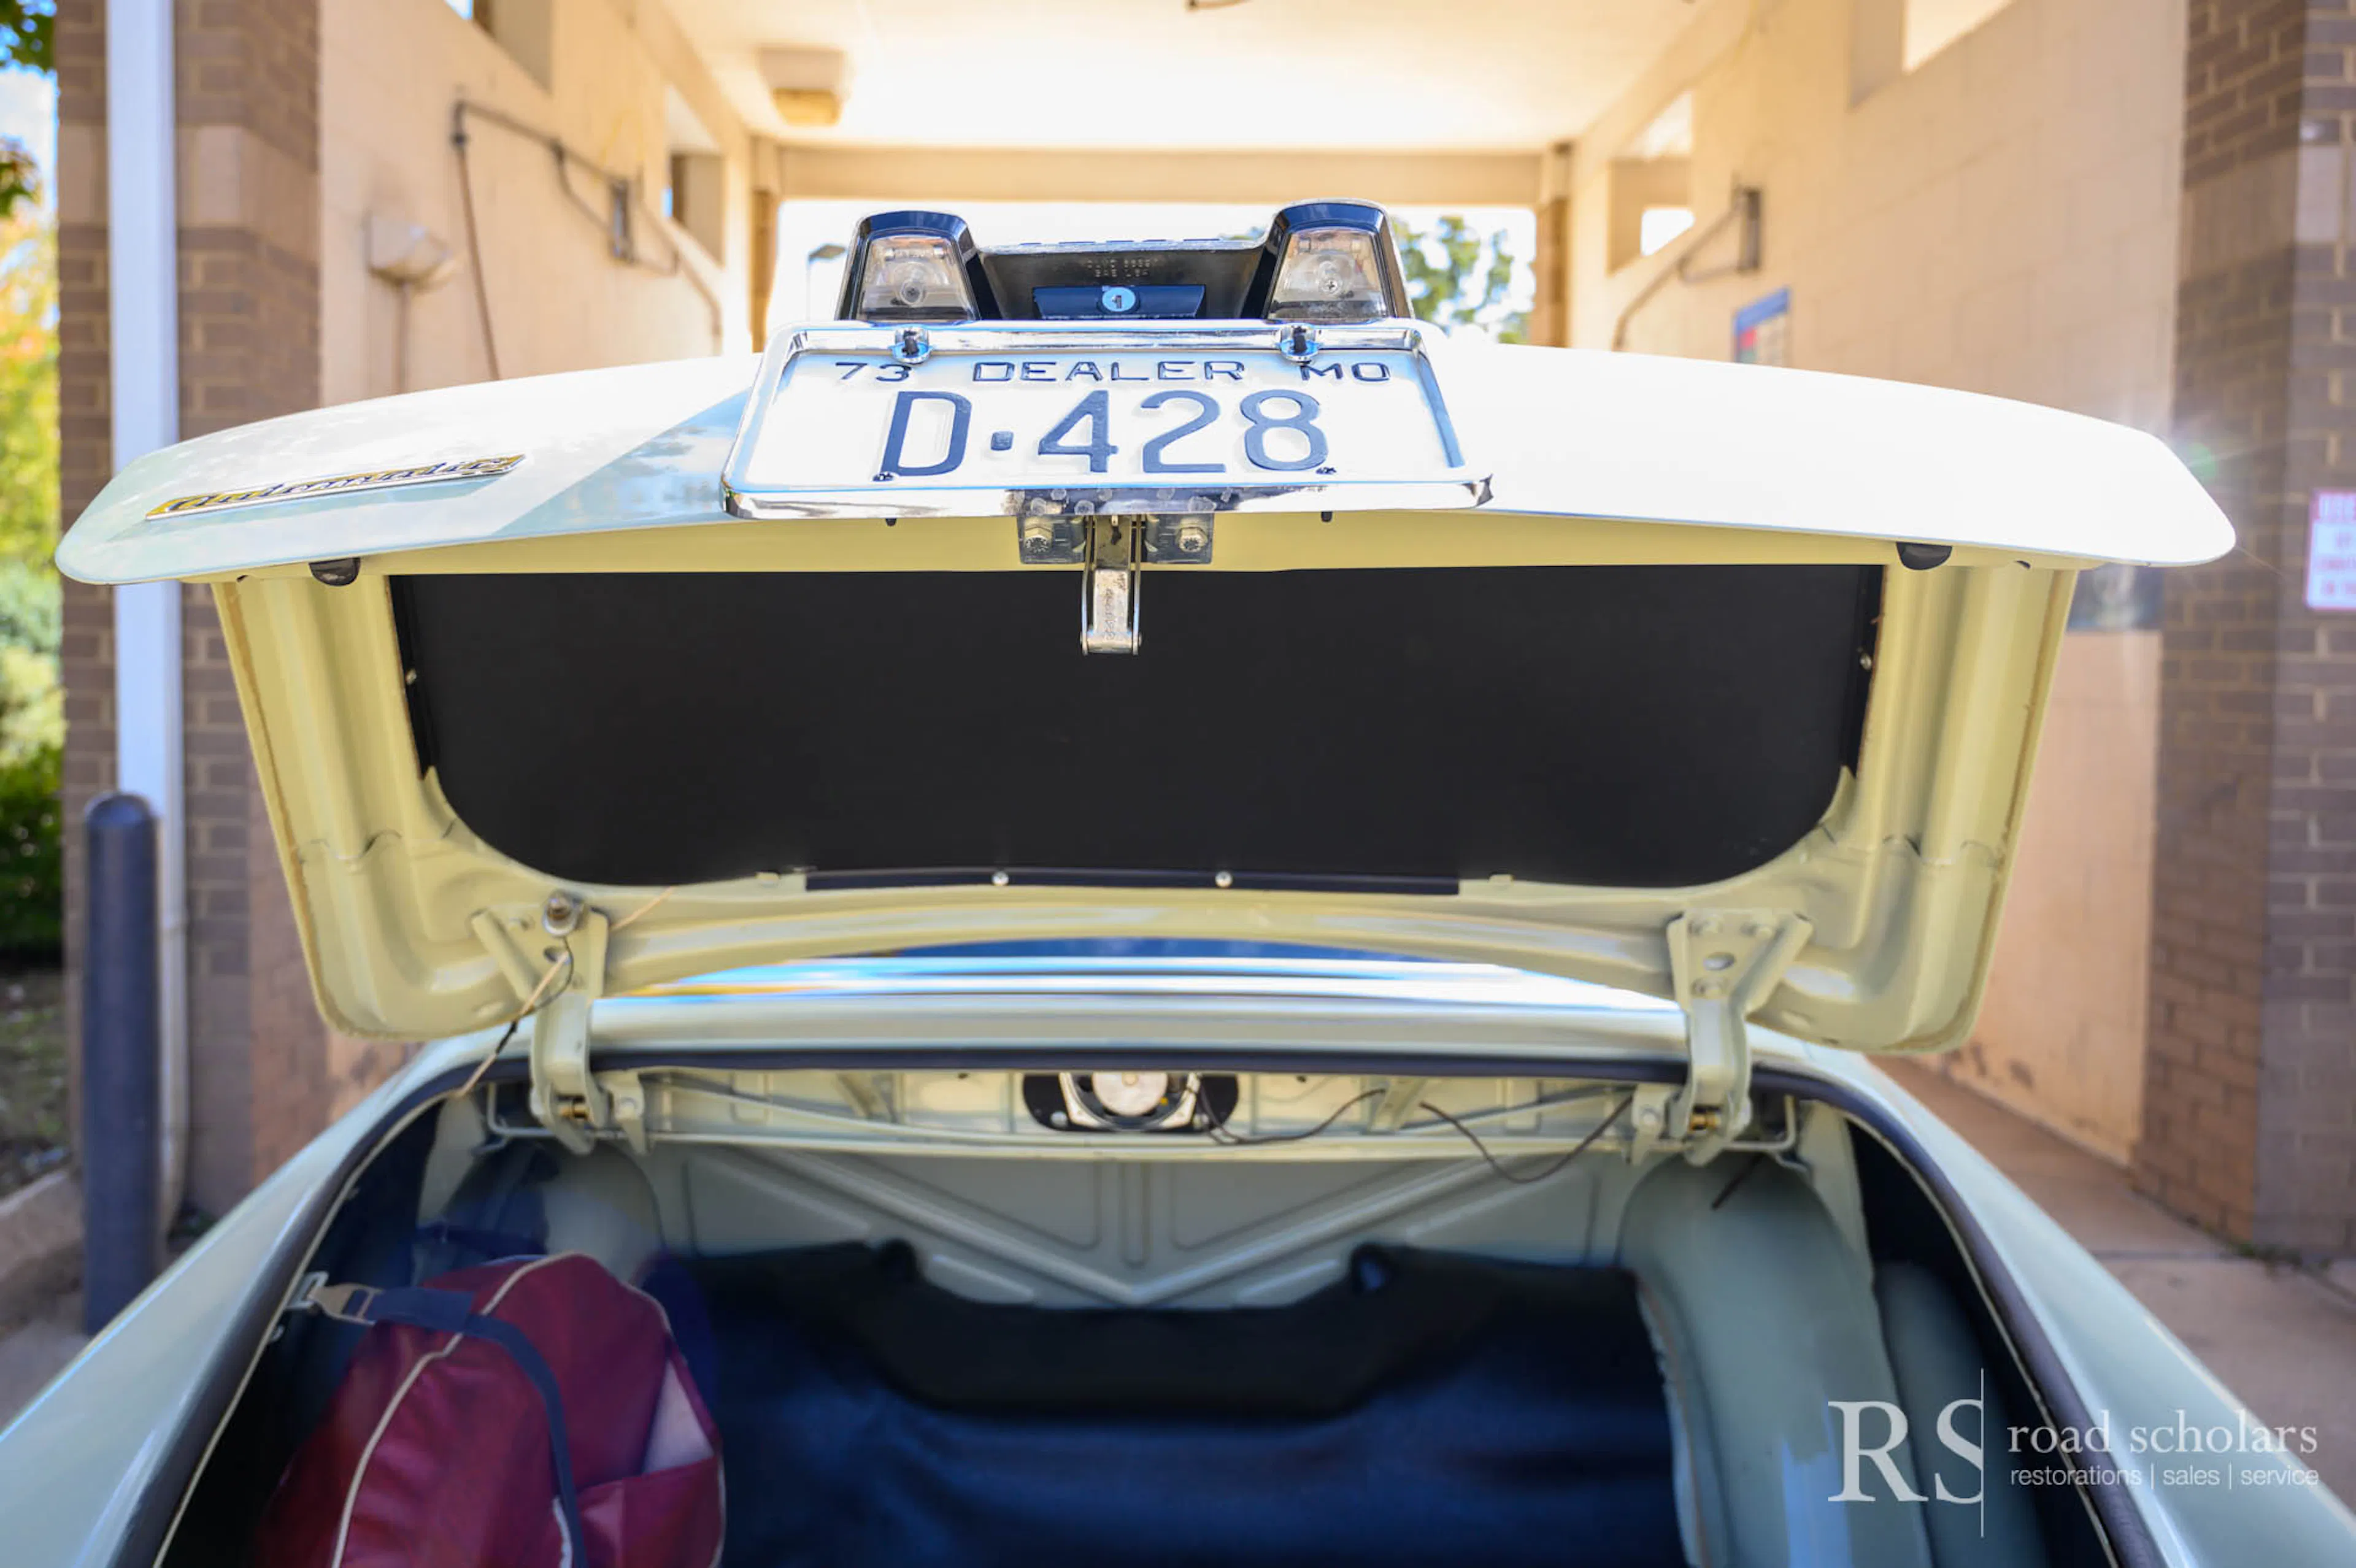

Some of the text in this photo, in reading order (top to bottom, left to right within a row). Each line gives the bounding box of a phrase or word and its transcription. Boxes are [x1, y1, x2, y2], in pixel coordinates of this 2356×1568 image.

[835, 361, 1391, 382] 73 DEALER MO
